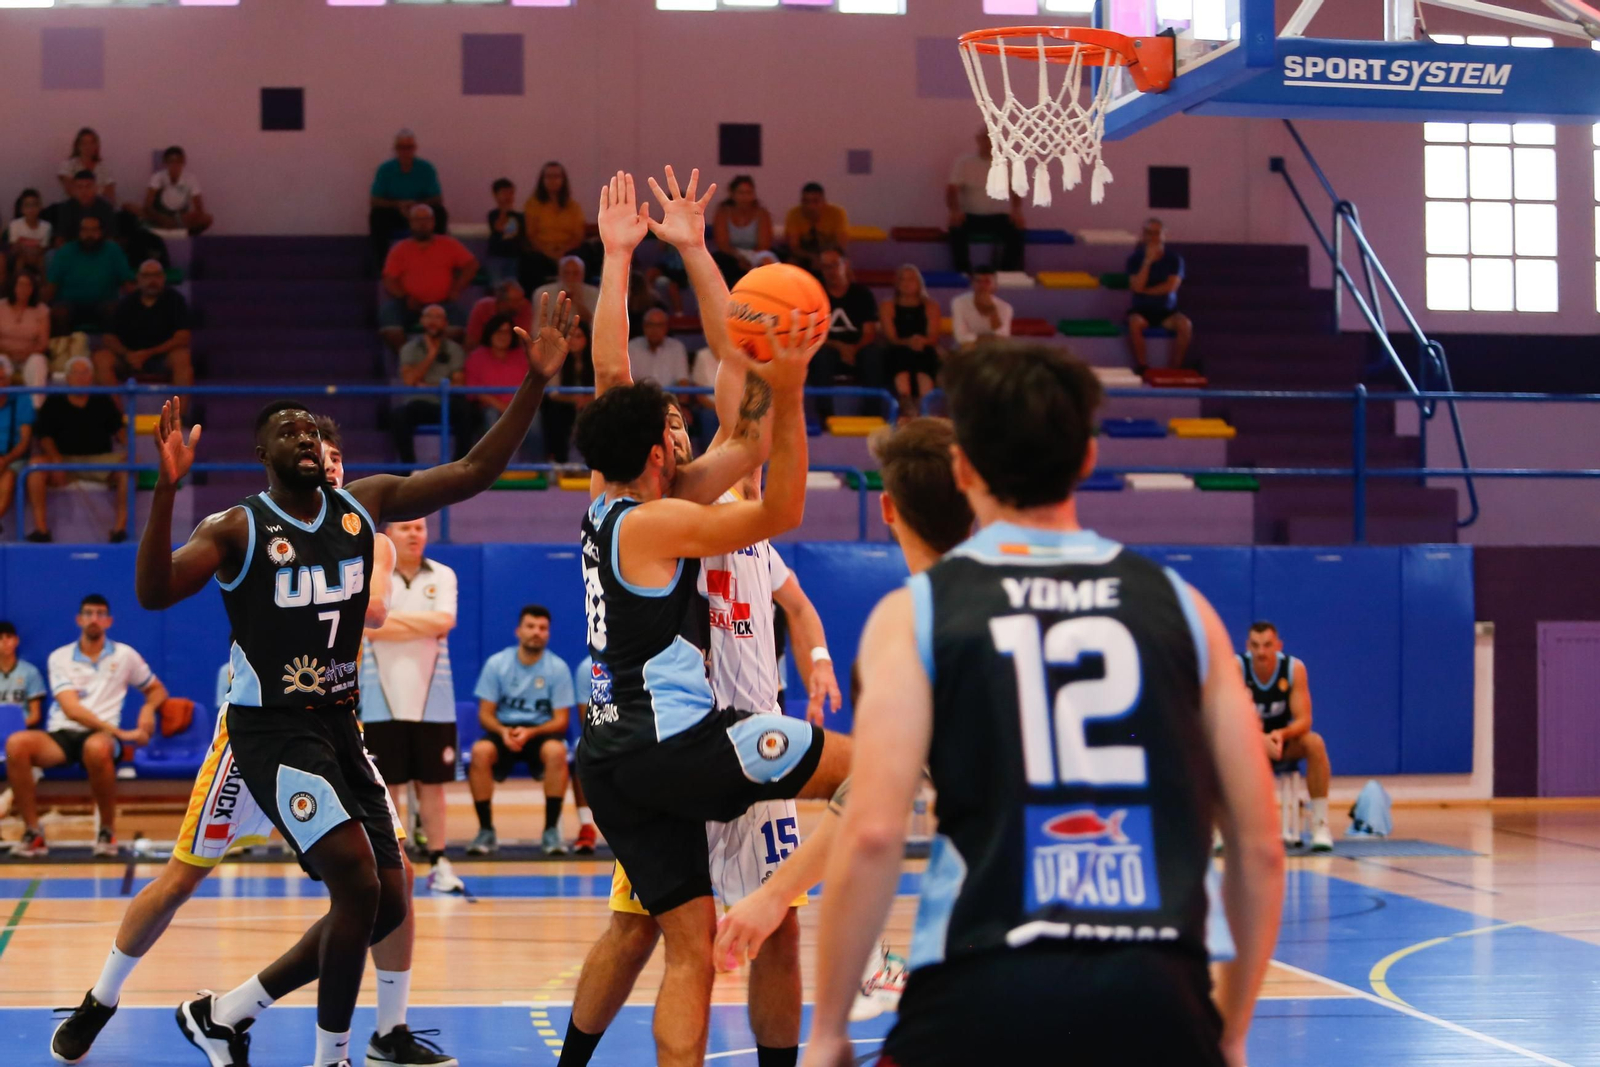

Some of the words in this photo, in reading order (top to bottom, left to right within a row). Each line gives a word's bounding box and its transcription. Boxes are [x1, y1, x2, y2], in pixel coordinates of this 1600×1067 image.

[1001, 577, 1122, 611] YOME
[318, 610, 341, 649] 7
[989, 614, 1149, 788] 12
[761, 816, 799, 865] 15
